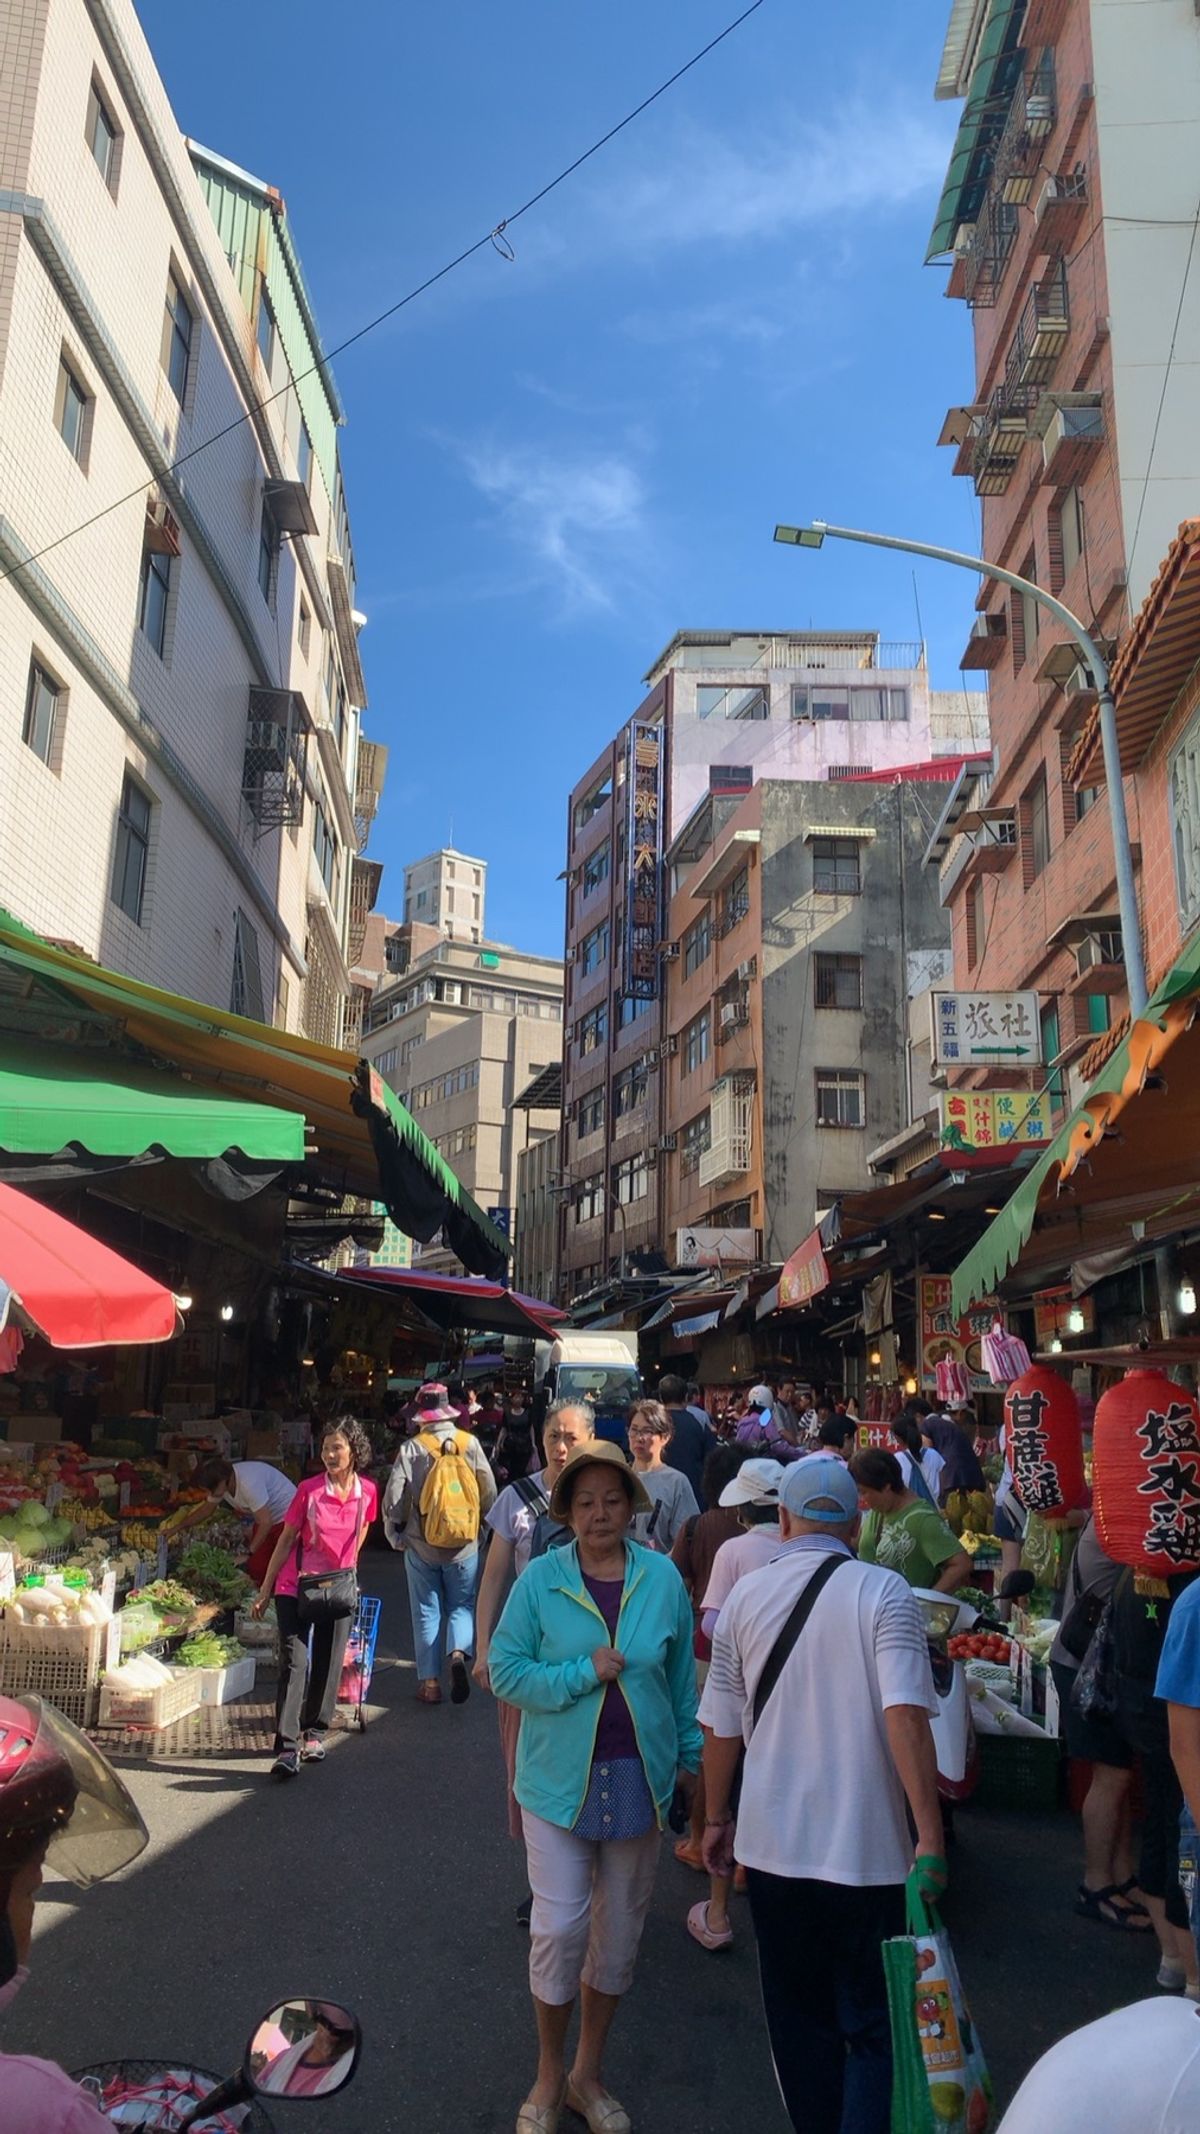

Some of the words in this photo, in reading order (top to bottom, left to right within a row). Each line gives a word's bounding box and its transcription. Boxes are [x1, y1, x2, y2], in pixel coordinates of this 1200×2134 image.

[941, 1000, 959, 1058] 新五福
[965, 1001, 1032, 1040] 旅社
[997, 1096, 1040, 1117] 便當
